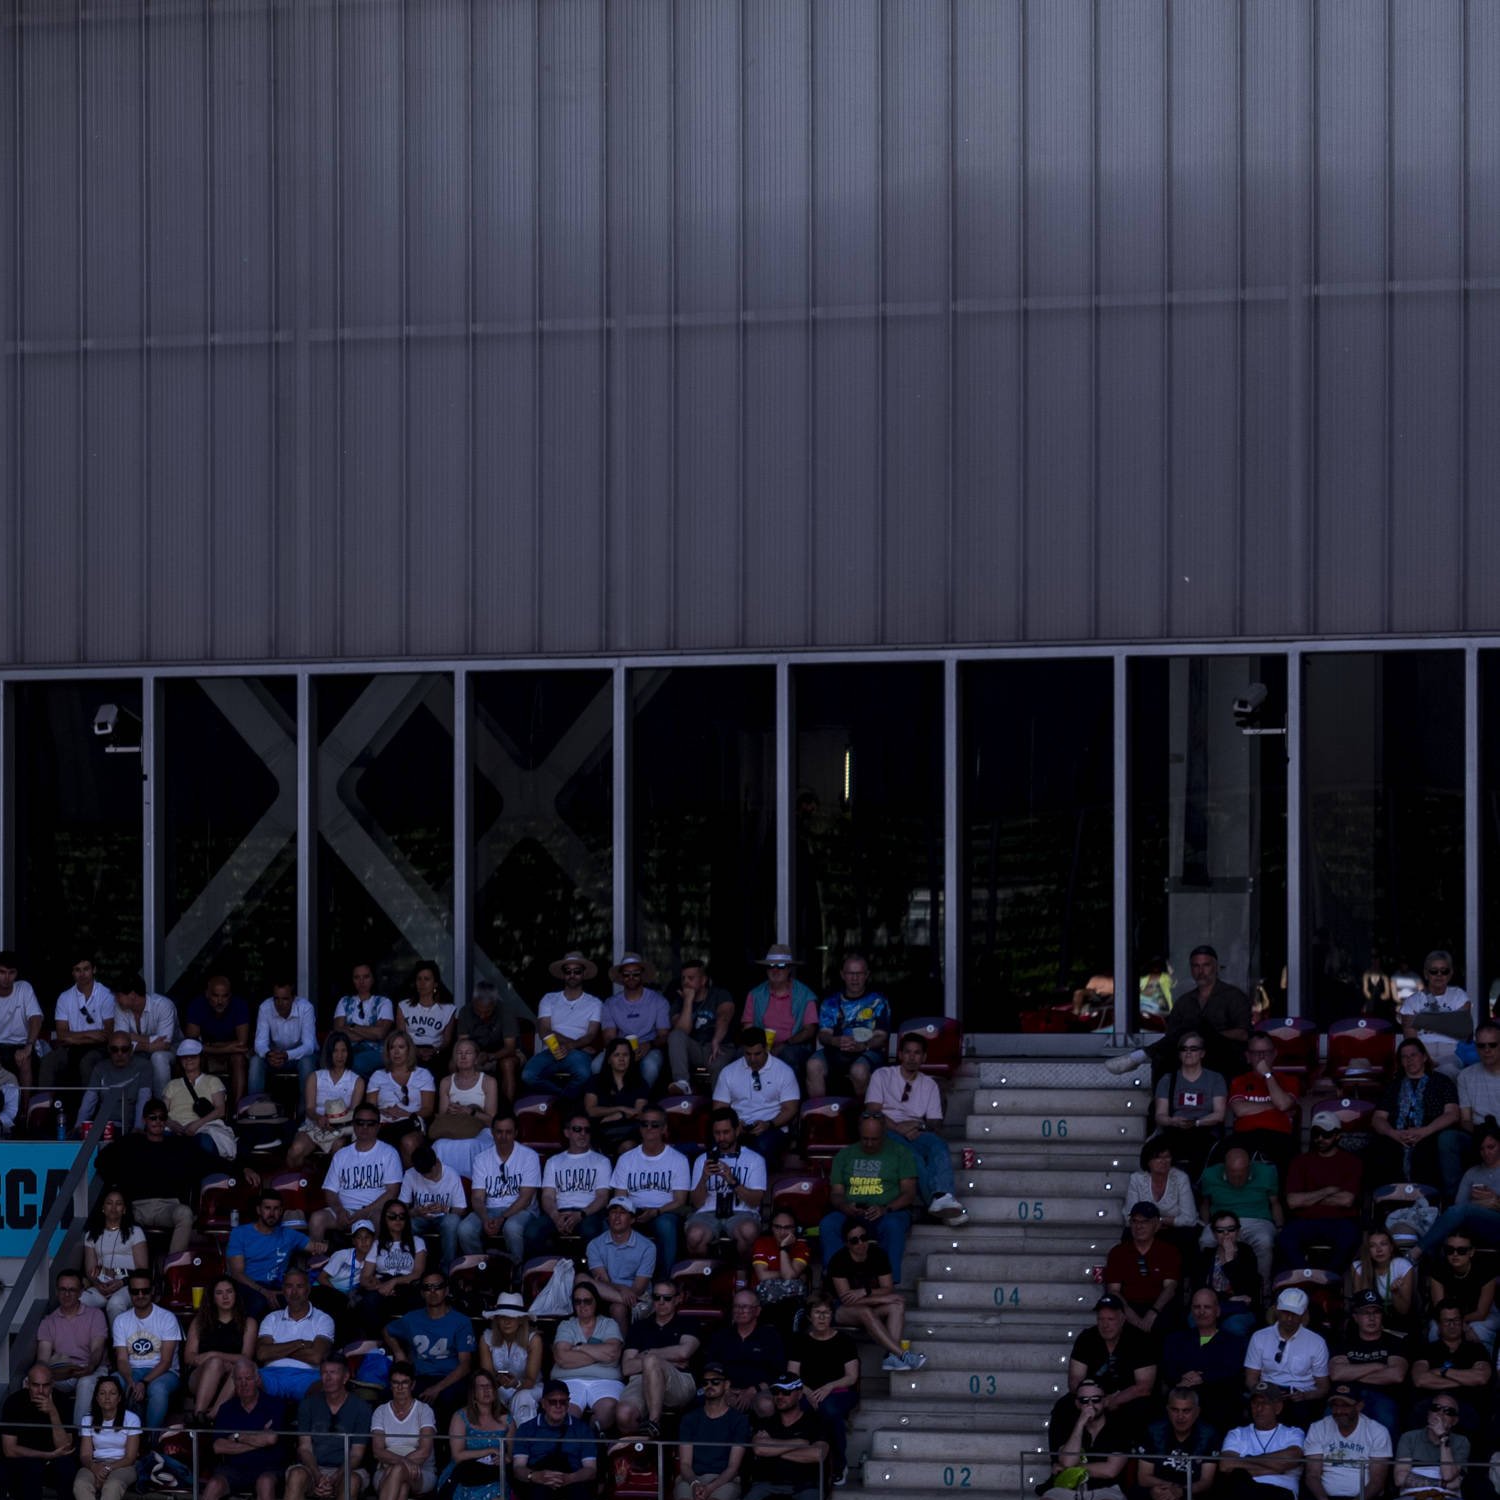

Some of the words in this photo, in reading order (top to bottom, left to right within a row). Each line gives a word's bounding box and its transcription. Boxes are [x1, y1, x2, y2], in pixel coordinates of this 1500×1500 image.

[406, 1015, 442, 1031] TANGO
[1041, 1119, 1068, 1138] 06
[339, 1163, 385, 1190] ALCARAZ
[554, 1168, 597, 1193] ALCARAZ
[627, 1170, 672, 1192] ALCARAZ
[849, 1185, 884, 1195] TENNIS
[1018, 1201, 1044, 1220] 05
[993, 1286, 1019, 1306] 04
[412, 1334, 450, 1359] 24
[969, 1375, 996, 1395] 03
[943, 1467, 971, 1487] 02
